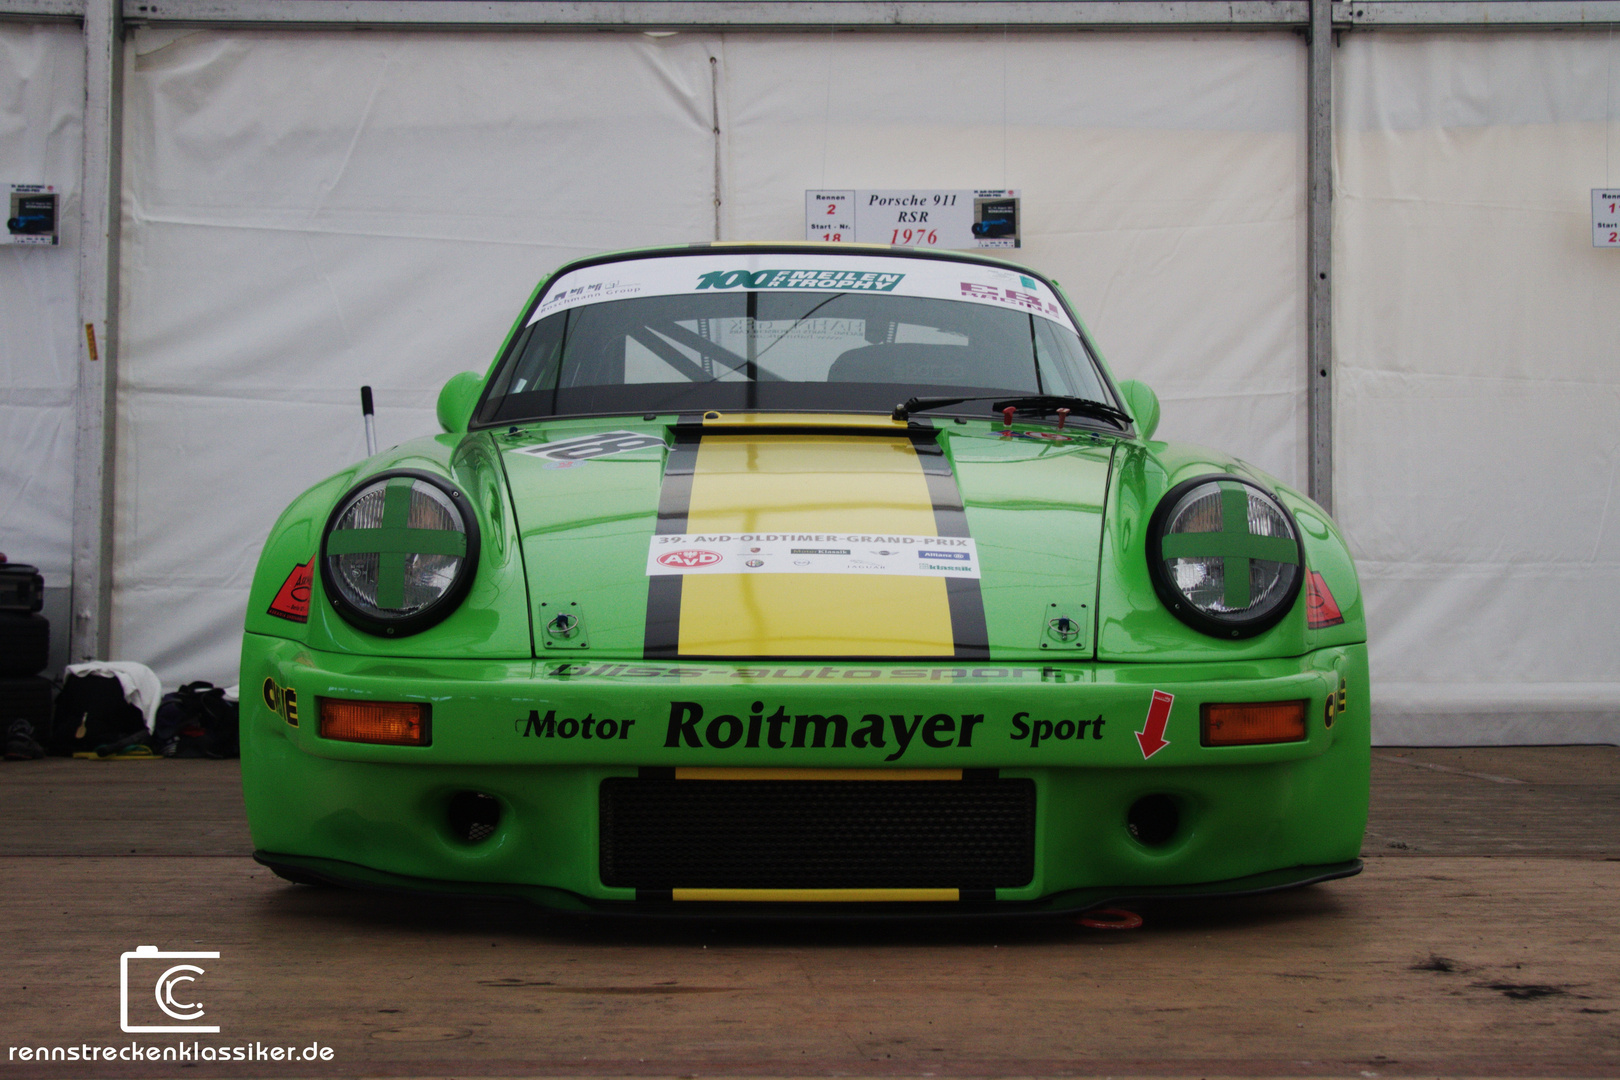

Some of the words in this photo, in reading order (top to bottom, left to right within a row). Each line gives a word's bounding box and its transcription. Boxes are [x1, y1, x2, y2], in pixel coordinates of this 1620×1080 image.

[869, 194, 927, 206] Porsche
[933, 194, 957, 206] 911
[826, 204, 836, 215] 2
[898, 211, 930, 223] RSR
[823, 234, 841, 242] 18
[891, 228, 938, 245] 1976
[790, 271, 900, 282] MEILEN
[787, 280, 893, 290] TROPHY
[694, 534, 968, 546] AvD-OLDTIMER-GRAND-PRIX
[523, 710, 636, 740] Motor
[1010, 712, 1106, 748] Sport
[663, 701, 984, 762] Roitmayer
